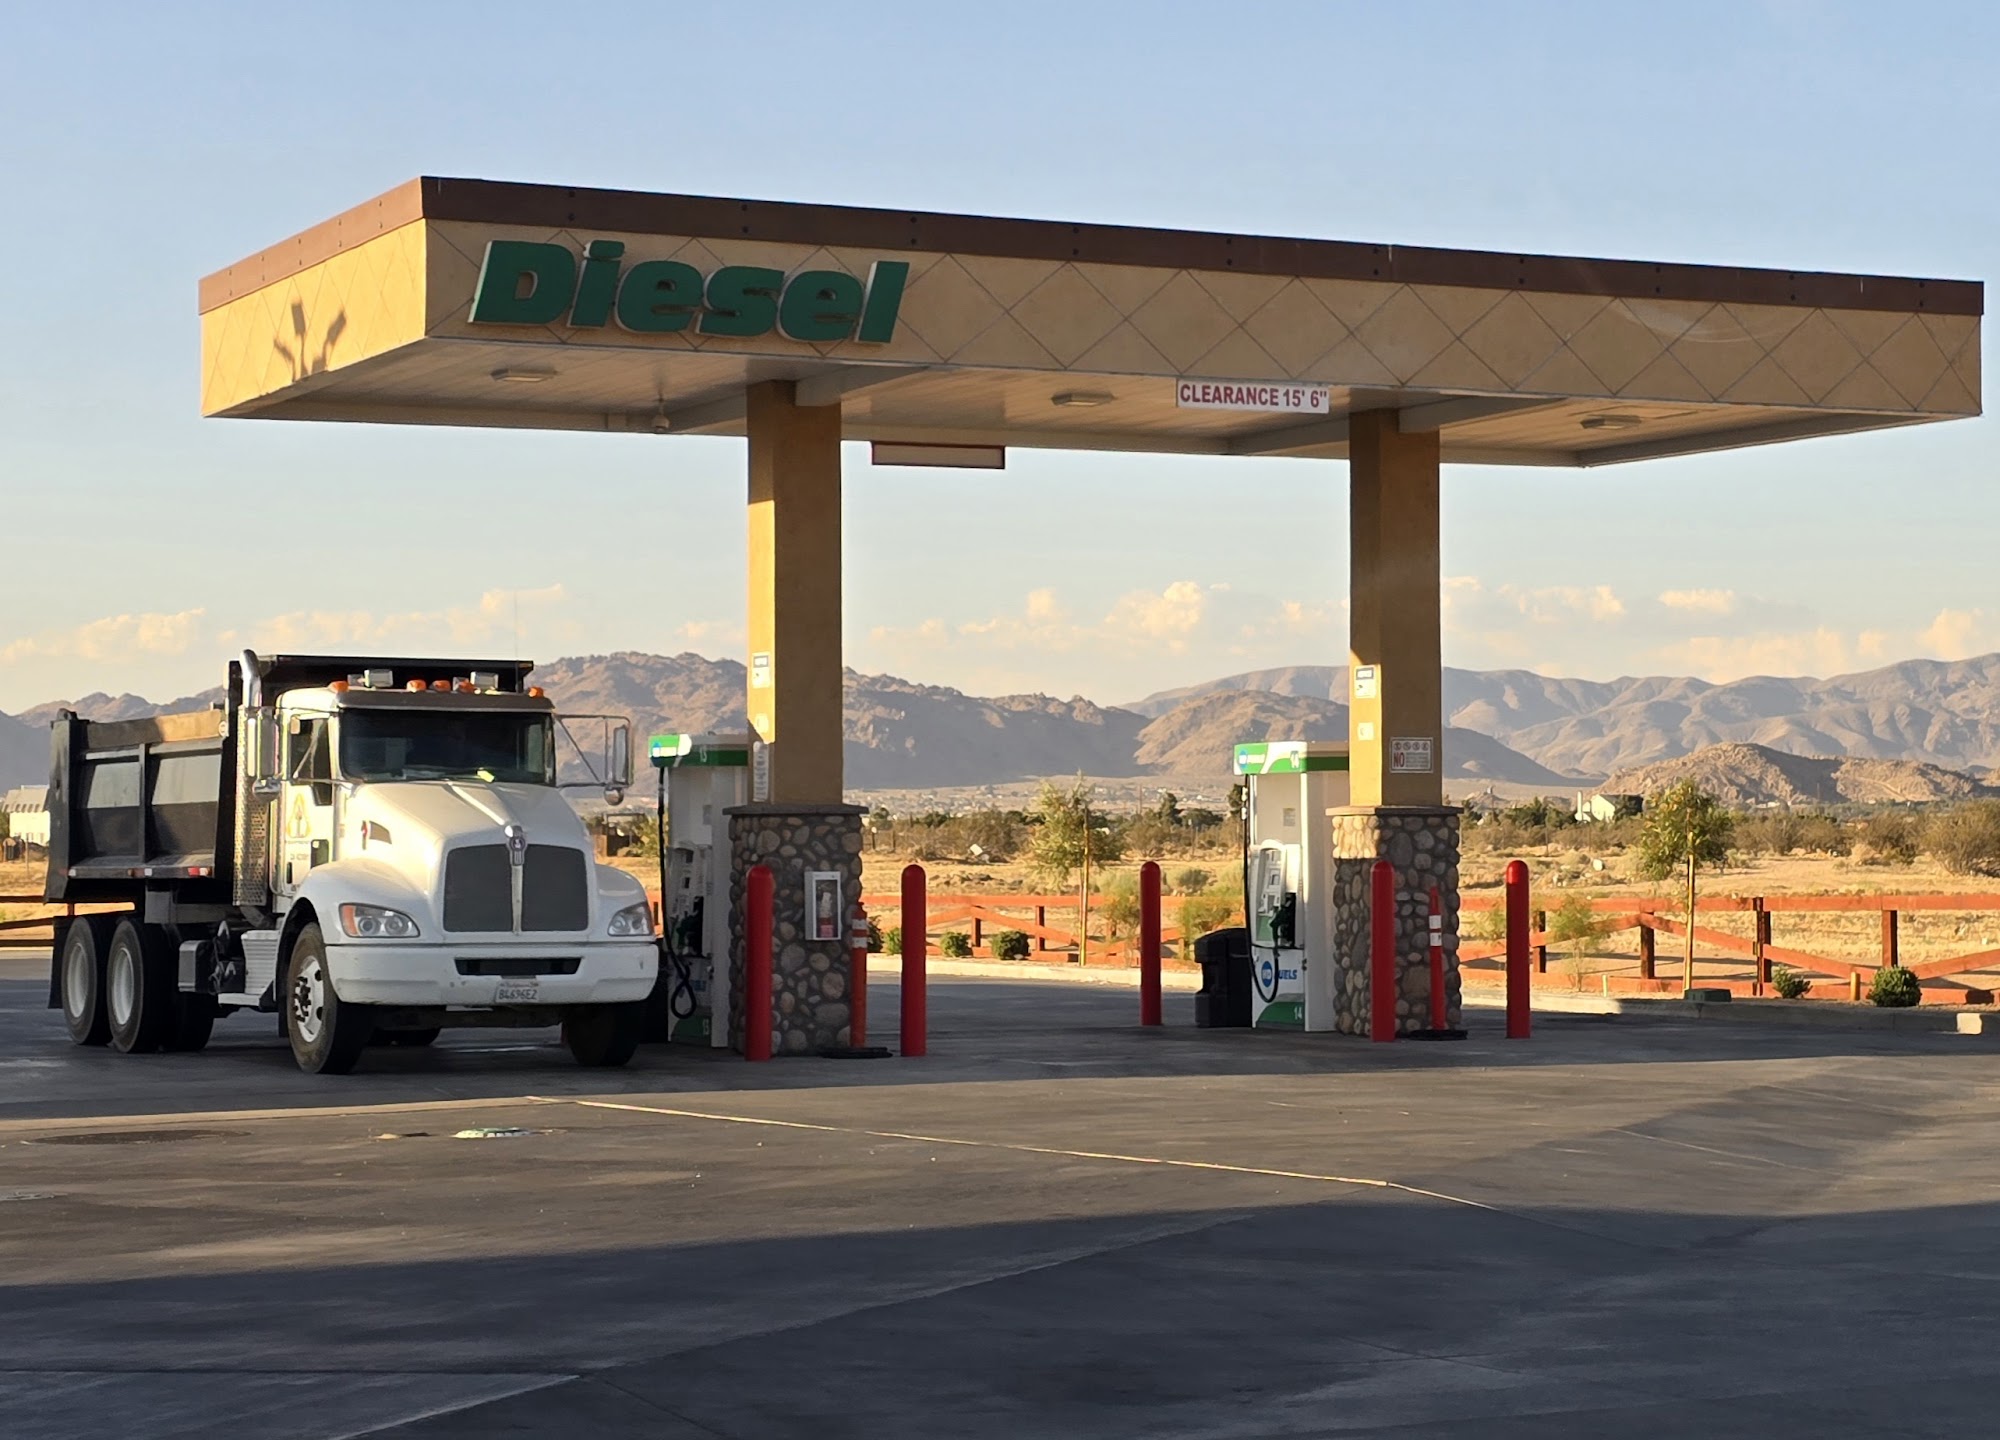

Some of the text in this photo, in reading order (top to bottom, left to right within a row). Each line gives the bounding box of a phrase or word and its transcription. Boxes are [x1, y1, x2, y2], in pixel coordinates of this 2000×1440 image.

[467, 239, 910, 344] Diesel
[1180, 384, 1327, 408] CLEARANCE 15' 6"
[1393, 752, 1405, 767] NO
[1277, 969, 1298, 980] UELS
[1294, 1006, 1303, 1020] 14
